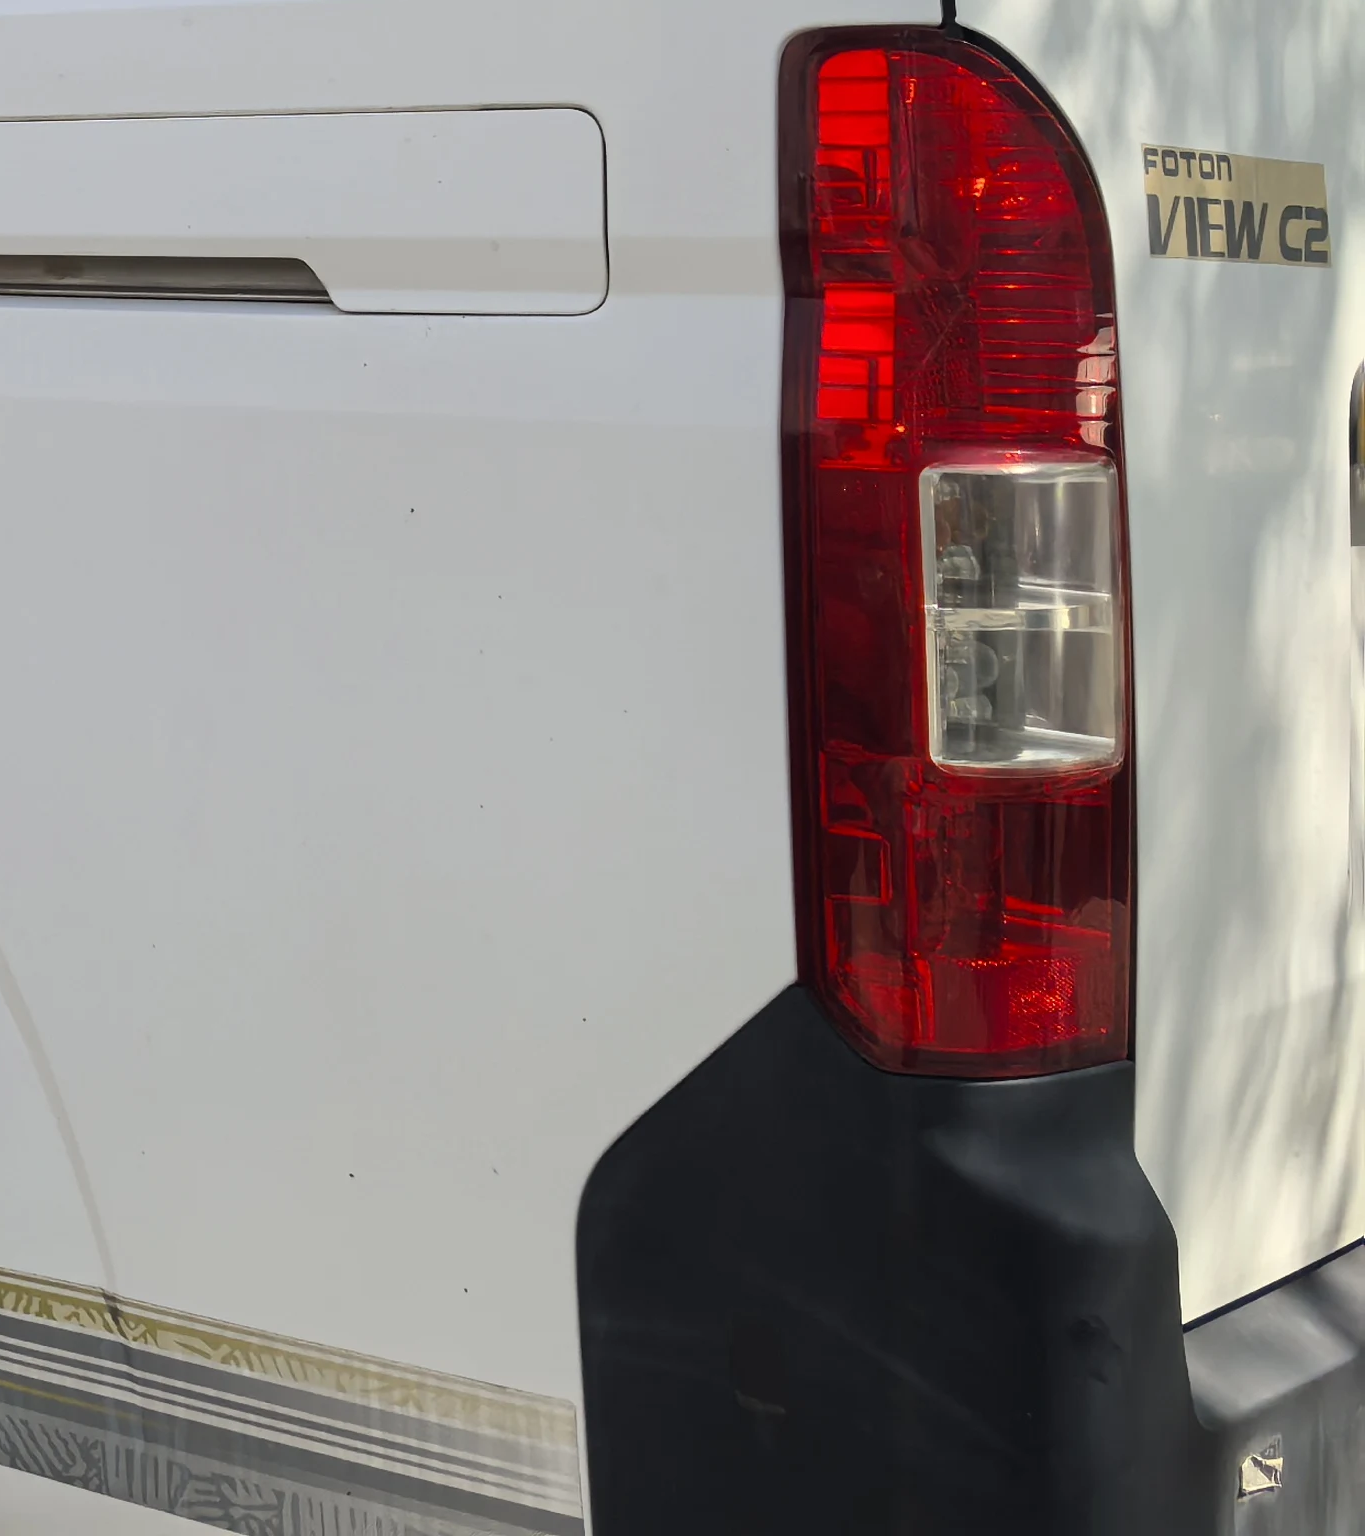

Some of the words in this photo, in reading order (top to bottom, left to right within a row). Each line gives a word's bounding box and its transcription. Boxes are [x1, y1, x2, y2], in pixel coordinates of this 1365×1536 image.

[1143, 147, 1233, 181] FOTON
[1146, 194, 1268, 260] VIEW
[1279, 205, 1329, 264] C2
